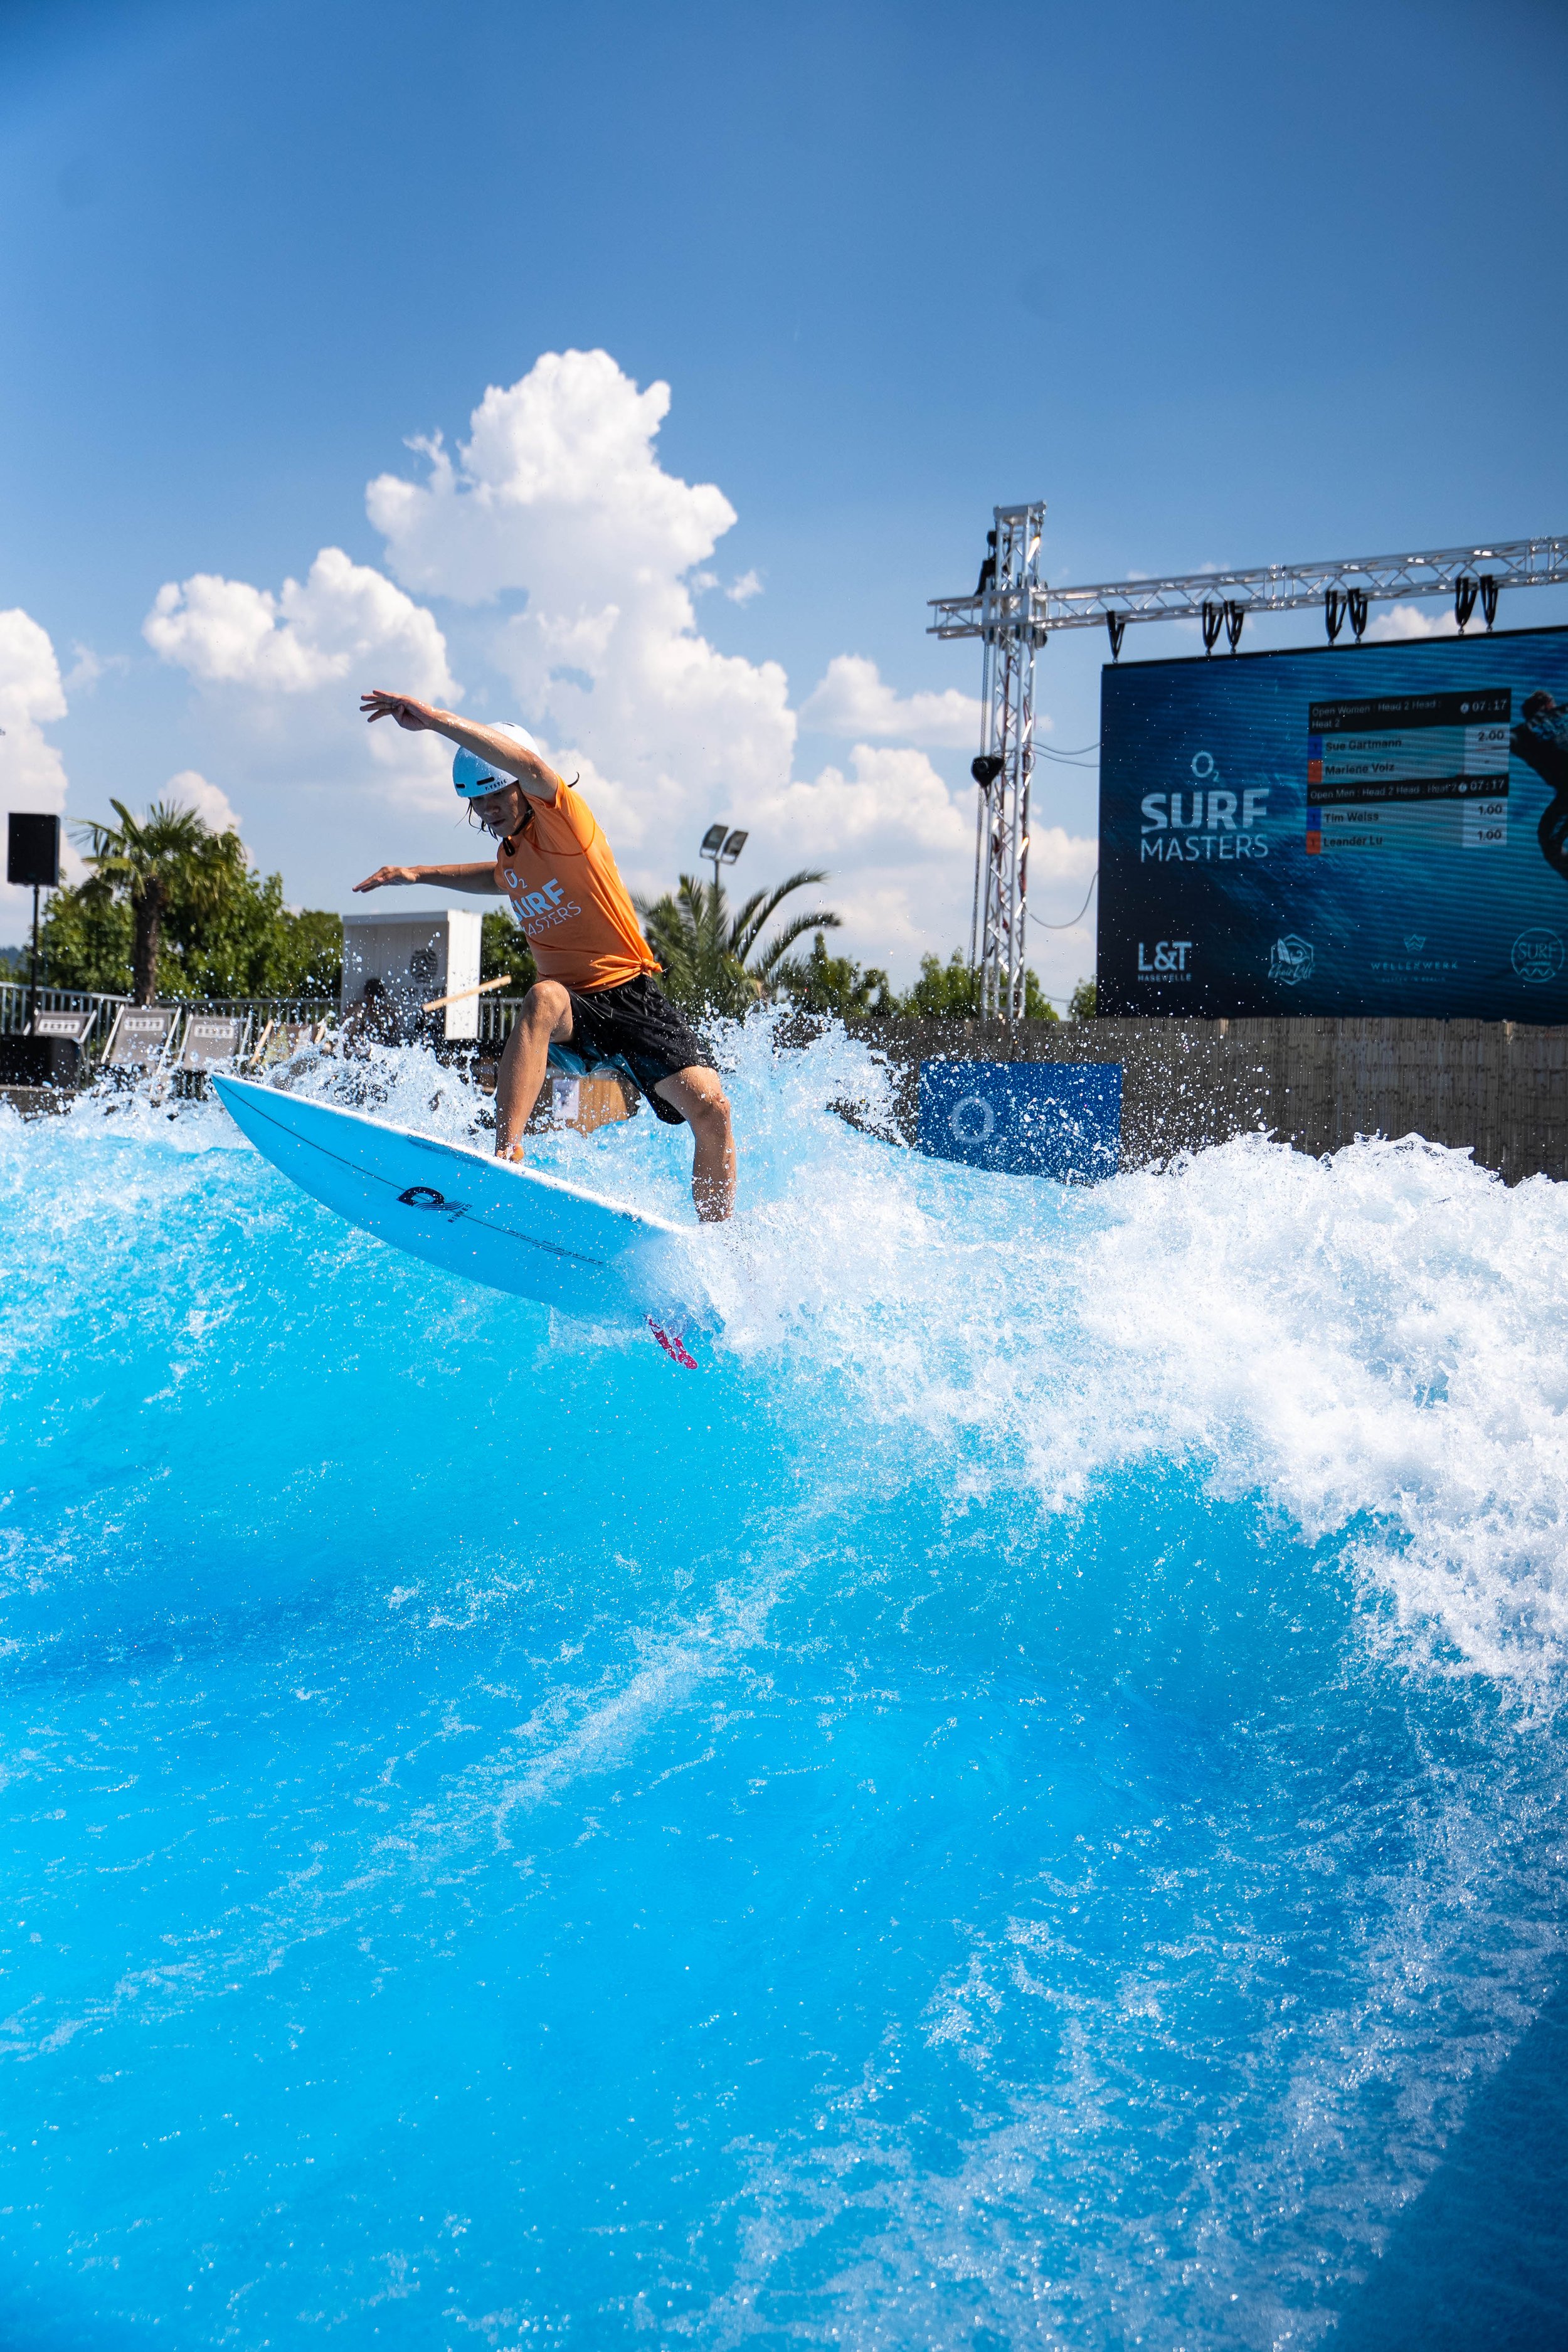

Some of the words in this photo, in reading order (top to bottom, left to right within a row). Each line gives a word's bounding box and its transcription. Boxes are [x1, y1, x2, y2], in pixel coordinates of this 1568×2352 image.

[1312, 707, 1335, 718] Open
[1338, 704, 1370, 715] Women
[1379, 701, 1401, 711] Head
[1404, 701, 1409, 711] 2
[1412, 699, 1436, 709] Head
[1311, 719, 1332, 729] Heat
[1334, 718, 1340, 728] 2
[1478, 729, 1504, 741] 2.00
[1325, 741, 1345, 751] Sue
[1310, 790, 1334, 802] Open
[1336, 788, 1355, 798] Men
[1362, 787, 1385, 797] Head
[1388, 785, 1394, 795] 2
[1397, 784, 1420, 795] Head
[1141, 788, 1269, 835] SURF
[1478, 803, 1503, 815] 1.00
[1324, 813, 1344, 823] Tim
[1347, 811, 1379, 822] Weiss
[1323, 835, 1367, 847] Leander
[1478, 829, 1502, 841] 1.00
[1141, 834, 1269, 863] MASTERS
[522, 901, 582, 938] ASTERS
[1138, 941, 1192, 972] L&T
[1518, 942, 1557, 960] SURF
[1370, 960, 1459, 970] WELLENWERK
[1138, 973, 1192, 982] HASEWELLE
